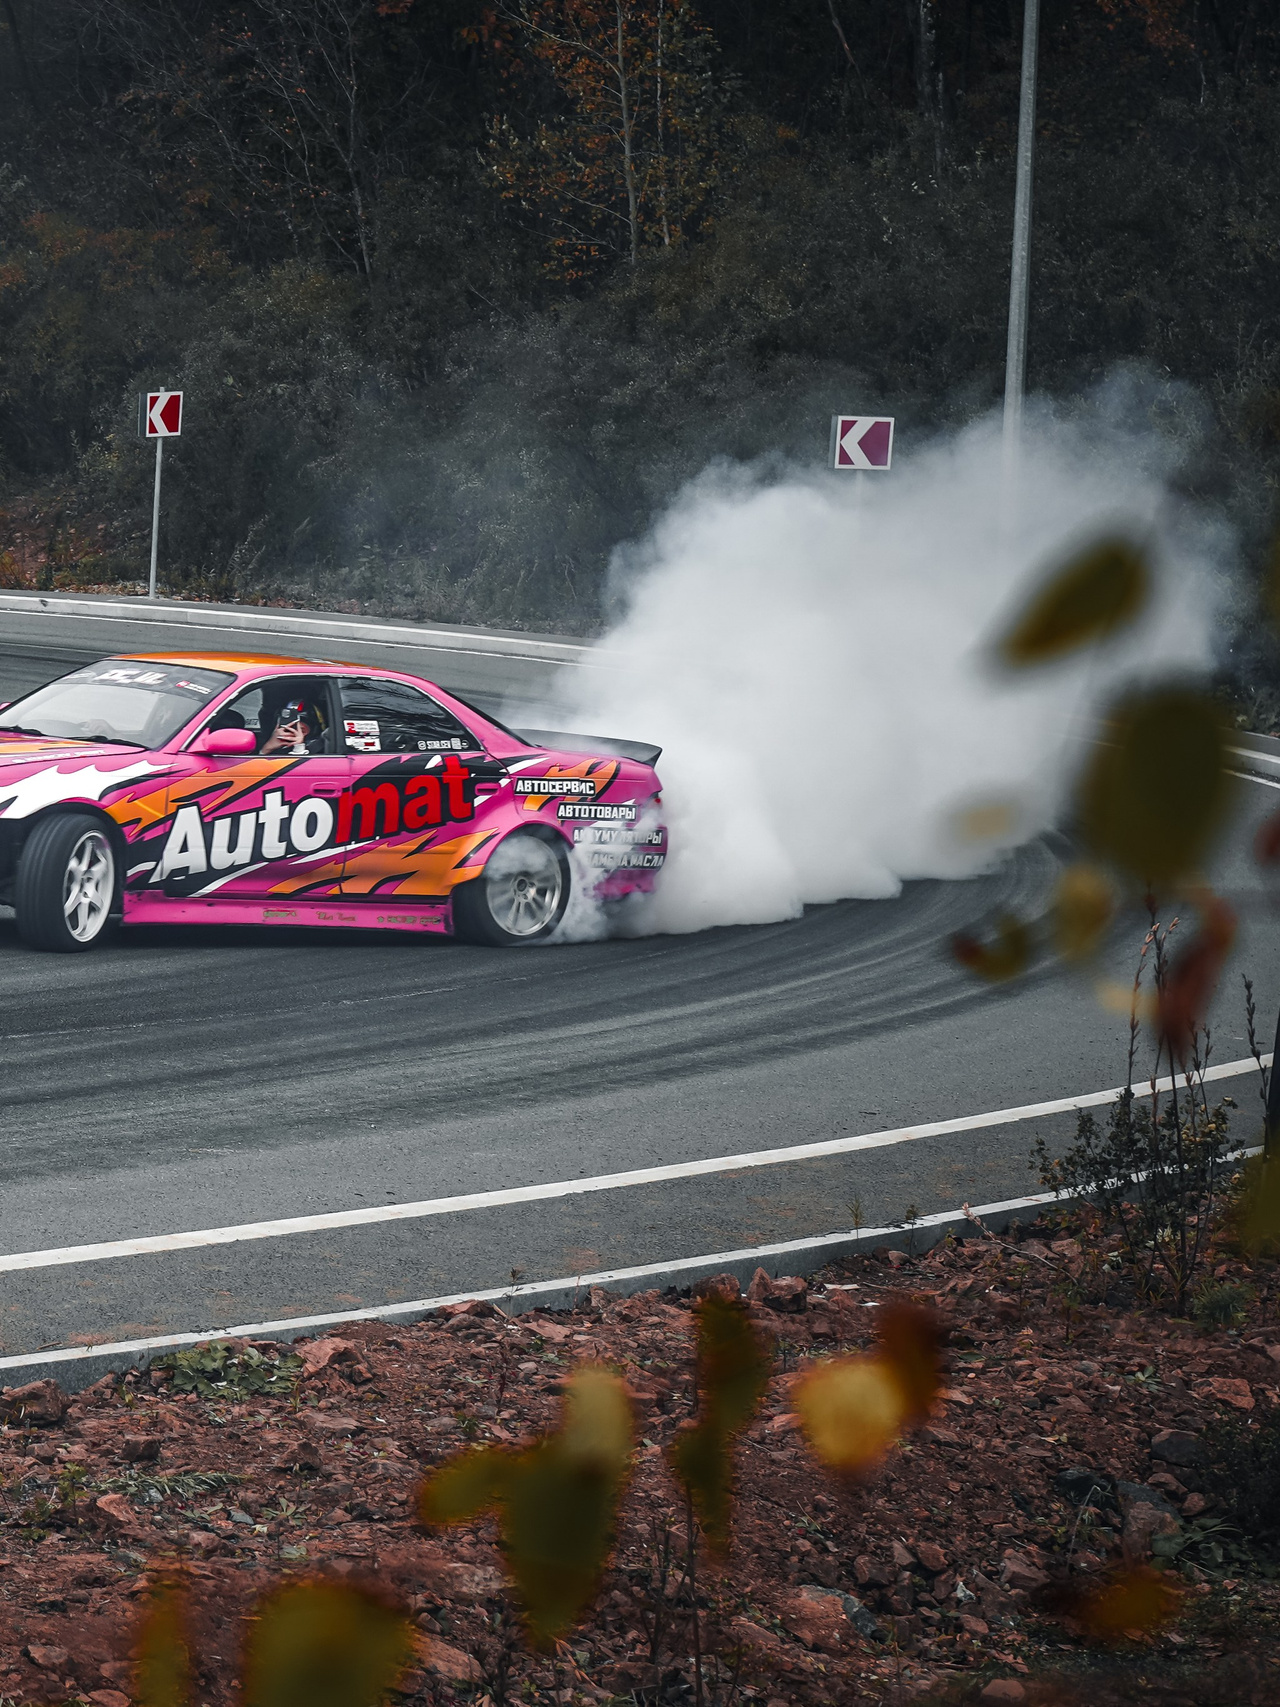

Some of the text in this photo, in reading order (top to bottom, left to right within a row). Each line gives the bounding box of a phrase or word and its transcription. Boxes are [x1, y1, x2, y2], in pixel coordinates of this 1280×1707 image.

[516, 780, 595, 795] АВТОСЕРВИС
[149, 755, 470, 883] Automat
[558, 805, 636, 820] АВТОТОВАРЫ
